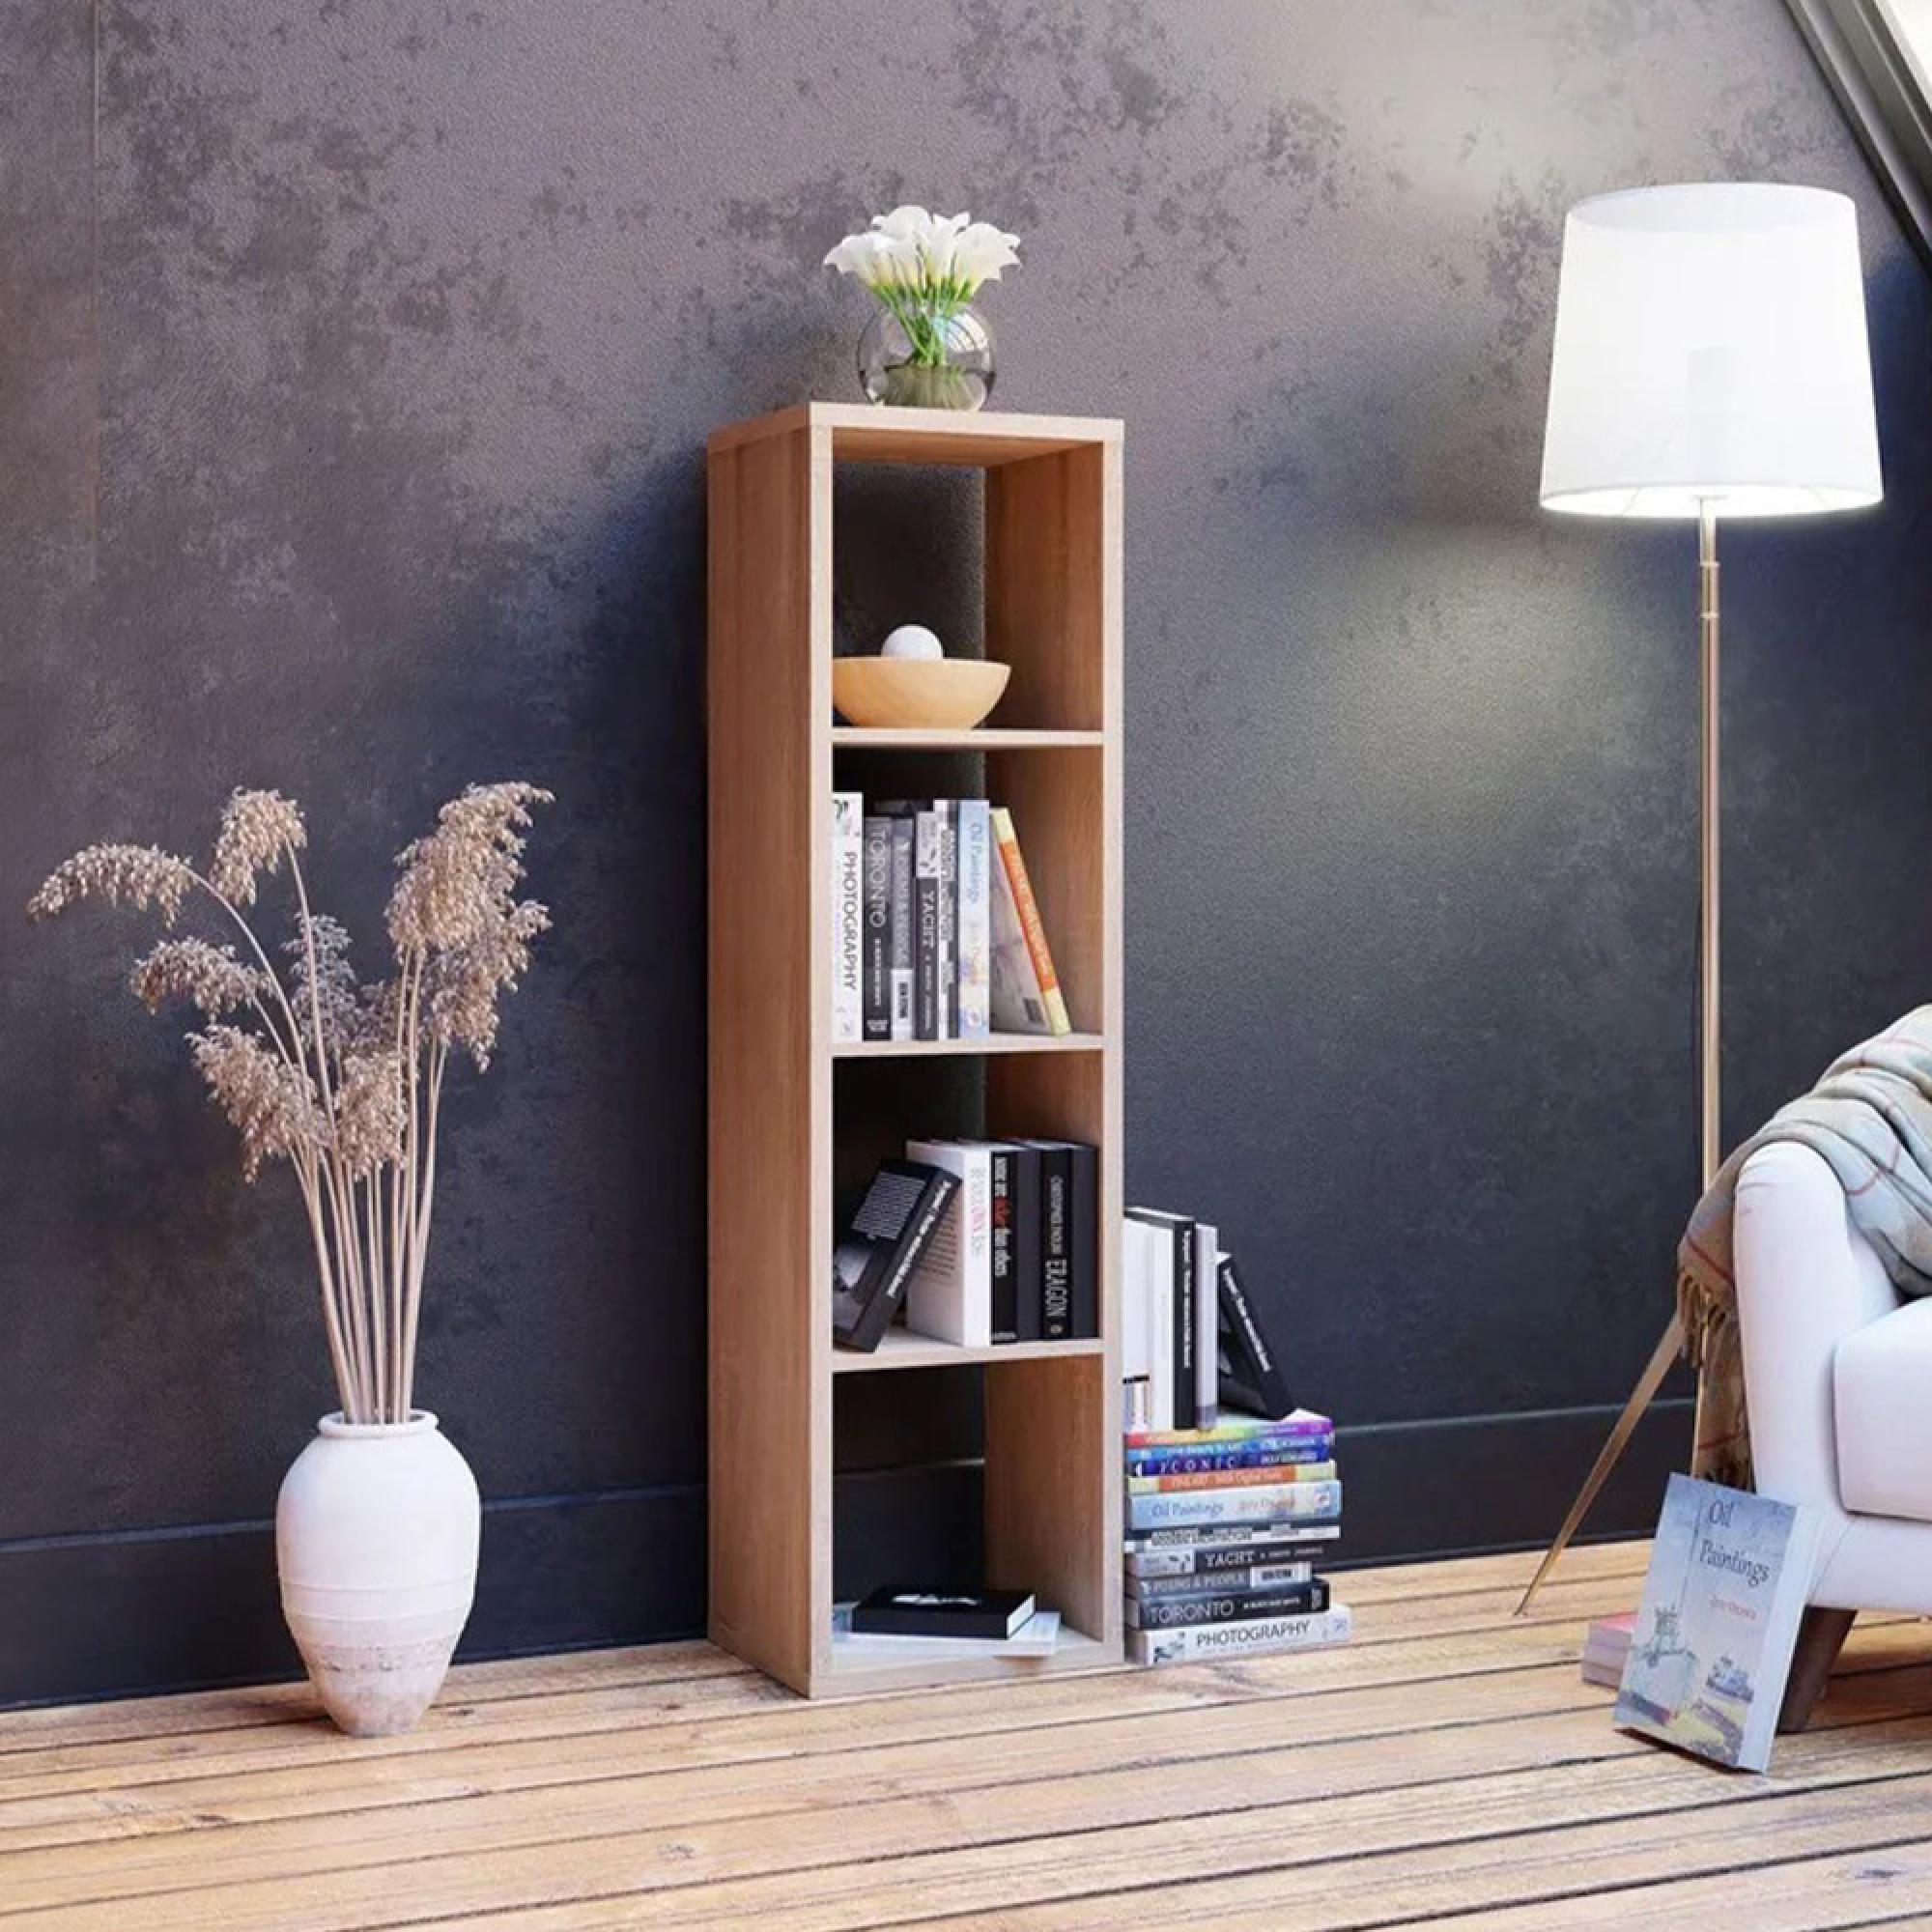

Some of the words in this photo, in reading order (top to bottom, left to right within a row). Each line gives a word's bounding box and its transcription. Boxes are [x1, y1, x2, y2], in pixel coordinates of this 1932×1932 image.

[869, 829, 887, 928] TORONTO
[843, 851, 858, 990] PHOTOGRAPHY
[1708, 1499, 1734, 1528] Oil
[1207, 1550, 1256, 1567] YACHT
[1699, 1538, 1771, 1588] Paintings
[1150, 1599, 1235, 1624] TORONTO
[1196, 1619, 1311, 1647] PHOTOGRAPHY
